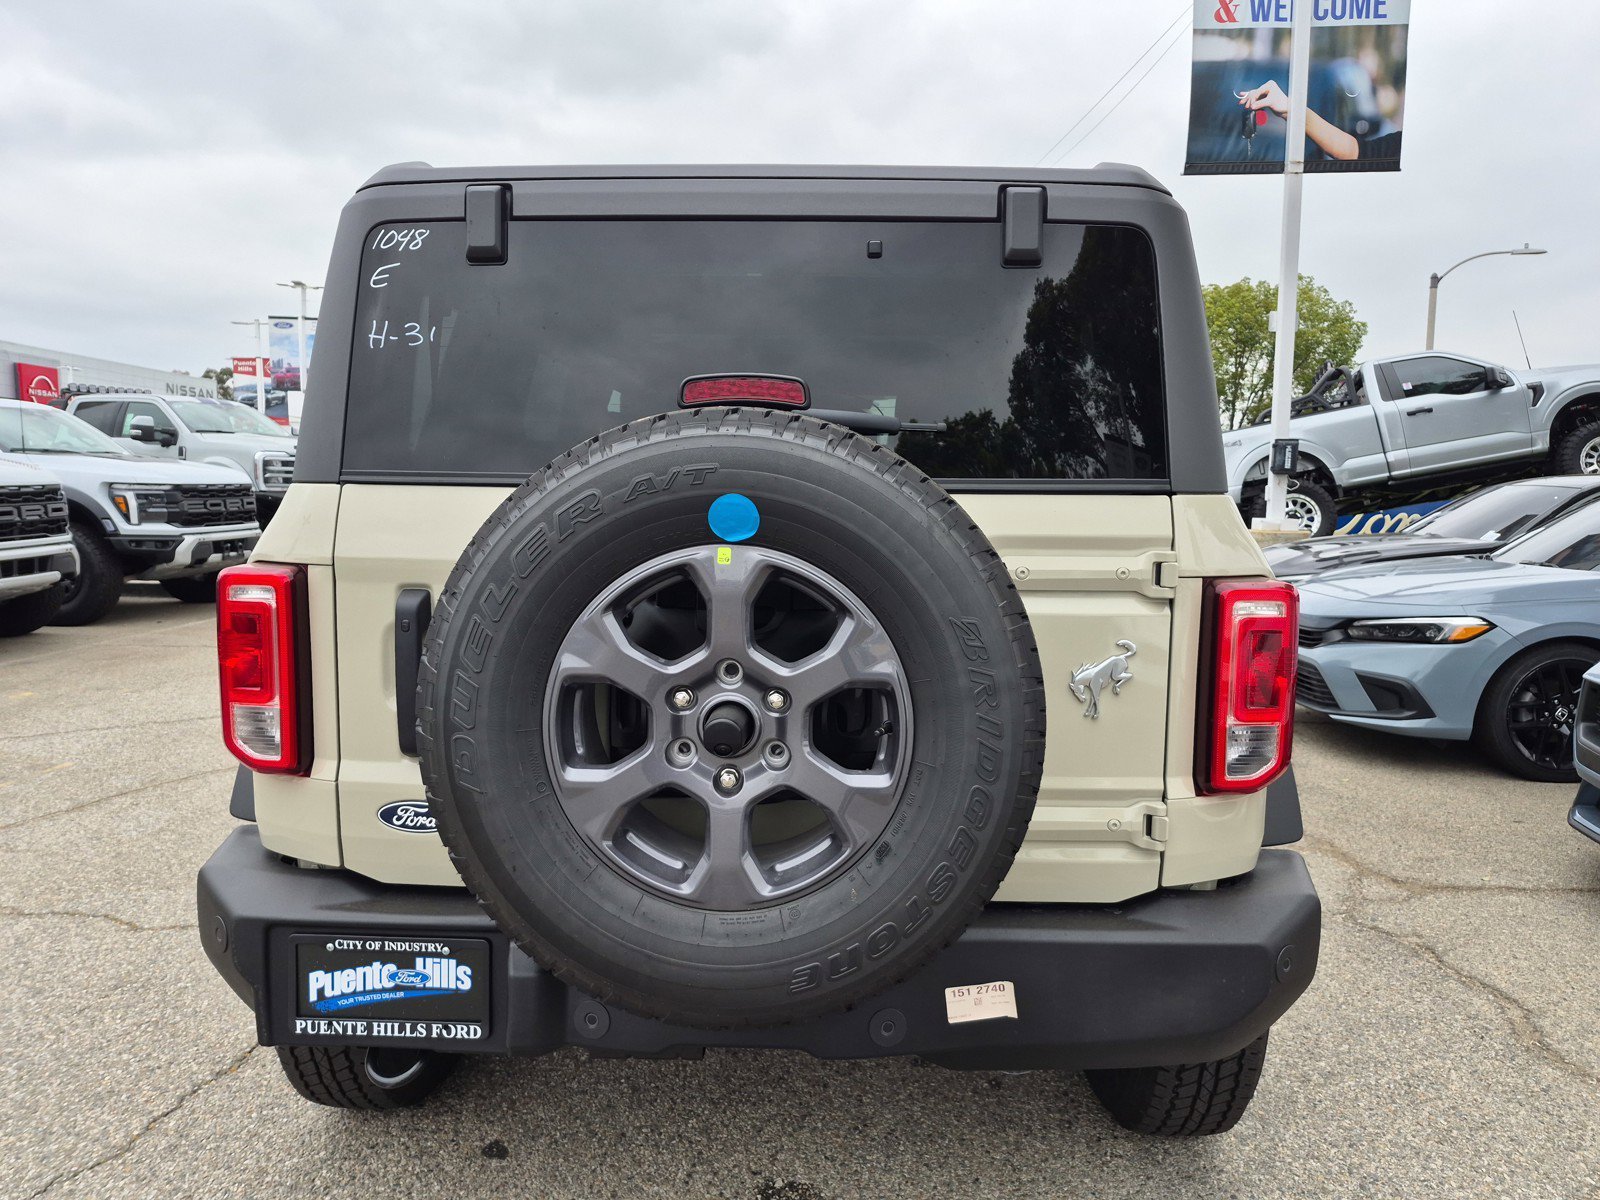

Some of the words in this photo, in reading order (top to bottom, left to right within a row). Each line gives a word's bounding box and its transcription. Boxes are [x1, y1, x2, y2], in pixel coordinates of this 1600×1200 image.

[1250, 0, 1388, 22] WECOME
[372, 228, 430, 251] 1048
[370, 262, 401, 288] E
[29, 388, 58, 398] NISSAN
[165, 382, 214, 398] NISSAN
[0, 503, 68, 520] ORD
[451, 488, 605, 794] DUELER
[789, 615, 1005, 995] BRIDGESTONE
[334, 939, 363, 950] CITY
[365, 940, 382, 951] OF
[384, 941, 443, 953] INDUSTRY
[308, 961, 397, 1002] Puente
[415, 957, 472, 990] Hills
[395, 971, 422, 983] Ford
[337, 997, 355, 1006] YOUR
[355, 993, 382, 1003] TRUSTED
[382, 991, 405, 999] DEALER
[951, 988, 971, 998] 151
[976, 983, 1006, 995] 2740
[294, 1020, 367, 1036] PUENTE
[372, 1022, 427, 1038] HILLS
[431, 1023, 482, 1039] FORD
